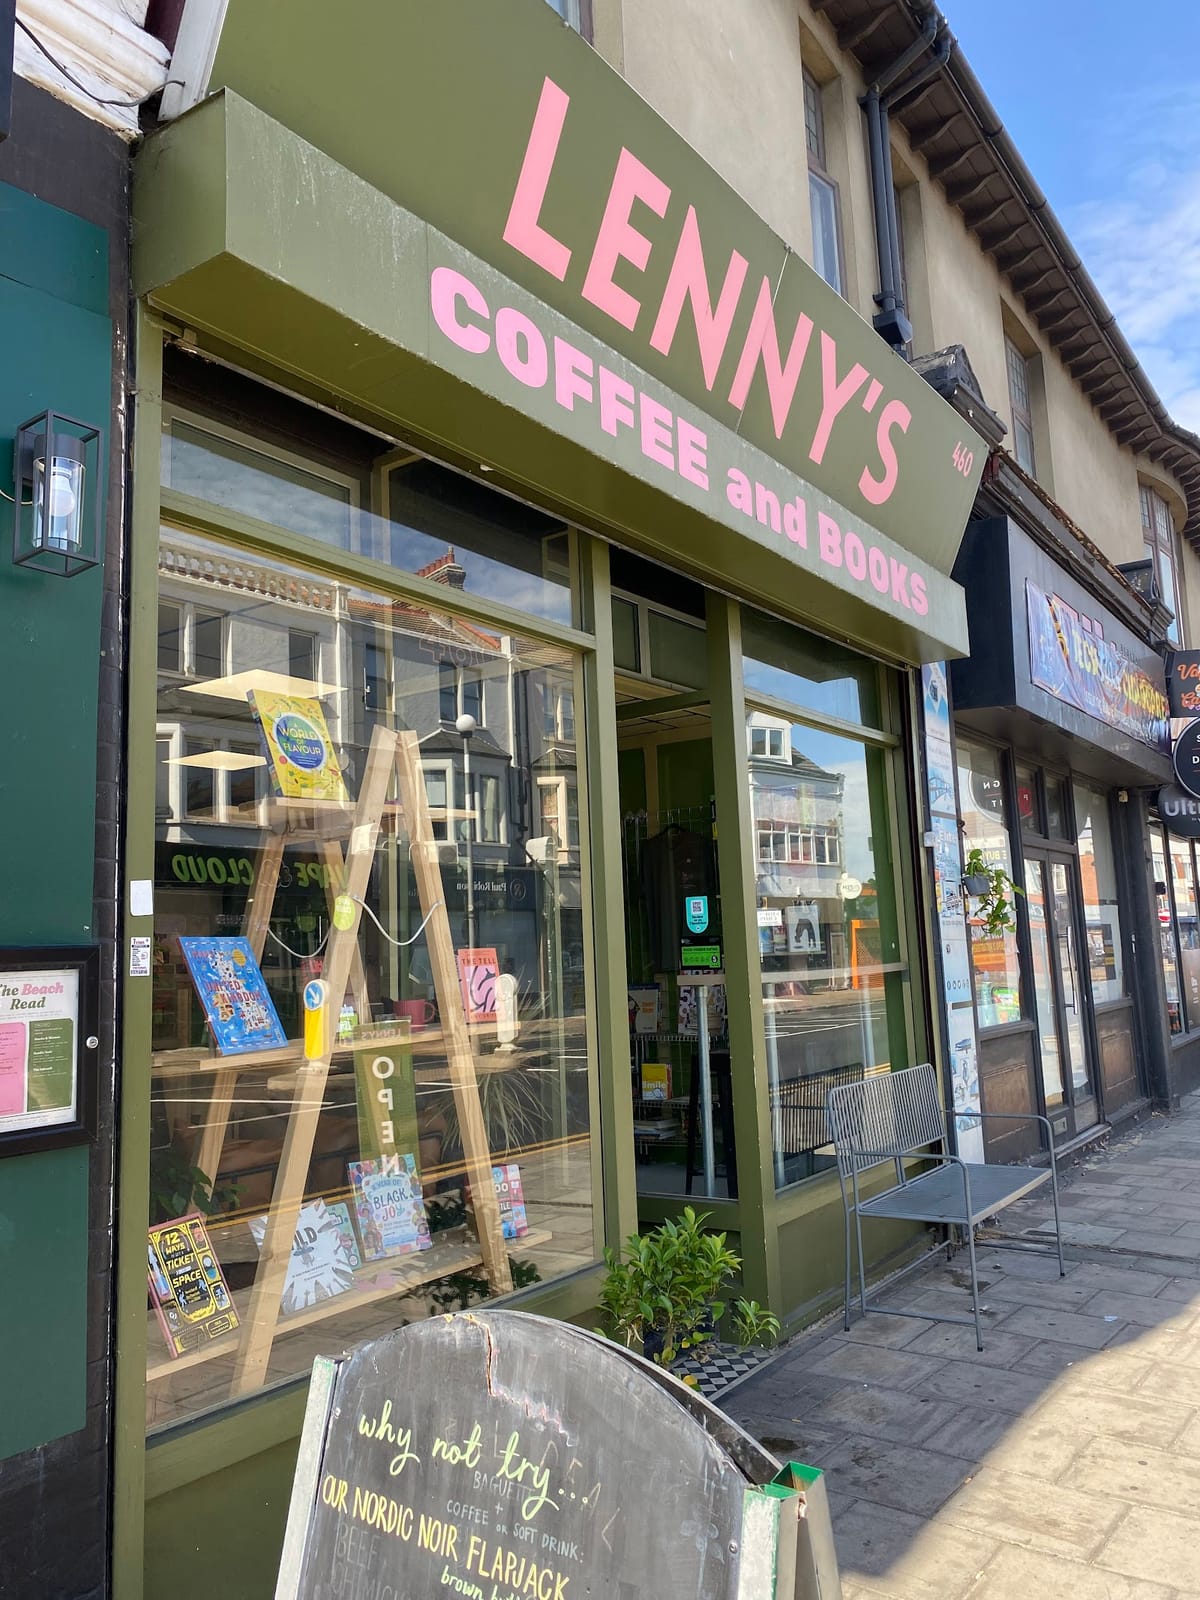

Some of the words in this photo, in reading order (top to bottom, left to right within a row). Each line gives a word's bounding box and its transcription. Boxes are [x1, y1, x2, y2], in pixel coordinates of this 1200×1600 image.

[503, 75, 912, 505] LENNY'S
[430, 266, 710, 492] COFFEE
[726, 466, 808, 549] and
[817, 510, 930, 616] BOOKS
[949, 441, 973, 478] 460
[278, 726, 318, 740] WORLD
[283, 742, 322, 755] FLAVOUR
[478, 957, 497, 965] TELL
[0, 983, 19, 997] he
[21, 981, 64, 996] Beach
[205, 980, 241, 992] UNITED
[10, 996, 46, 1010] Read
[220, 991, 262, 1003] KINGDOM
[373, 1187, 408, 1210] BLACK
[382, 1204, 406, 1221] JOY
[165, 1232, 180, 1245] 12
[165, 1243, 186, 1255] WAYS
[166, 1253, 195, 1271] TICKET
[172, 1269, 202, 1288] SPACE
[359, 1400, 420, 1476] why
[432, 1424, 483, 1468] not
[446, 1499, 489, 1526] COFFEE
[513, 1523, 538, 1545] SOFT
[322, 1475, 348, 1515] OUR
[352, 1486, 414, 1541] NORDIC
[418, 1514, 459, 1562] NOIR
[466, 1535, 570, 1600] FLAPJACK
[441, 1565, 485, 1600] brown
